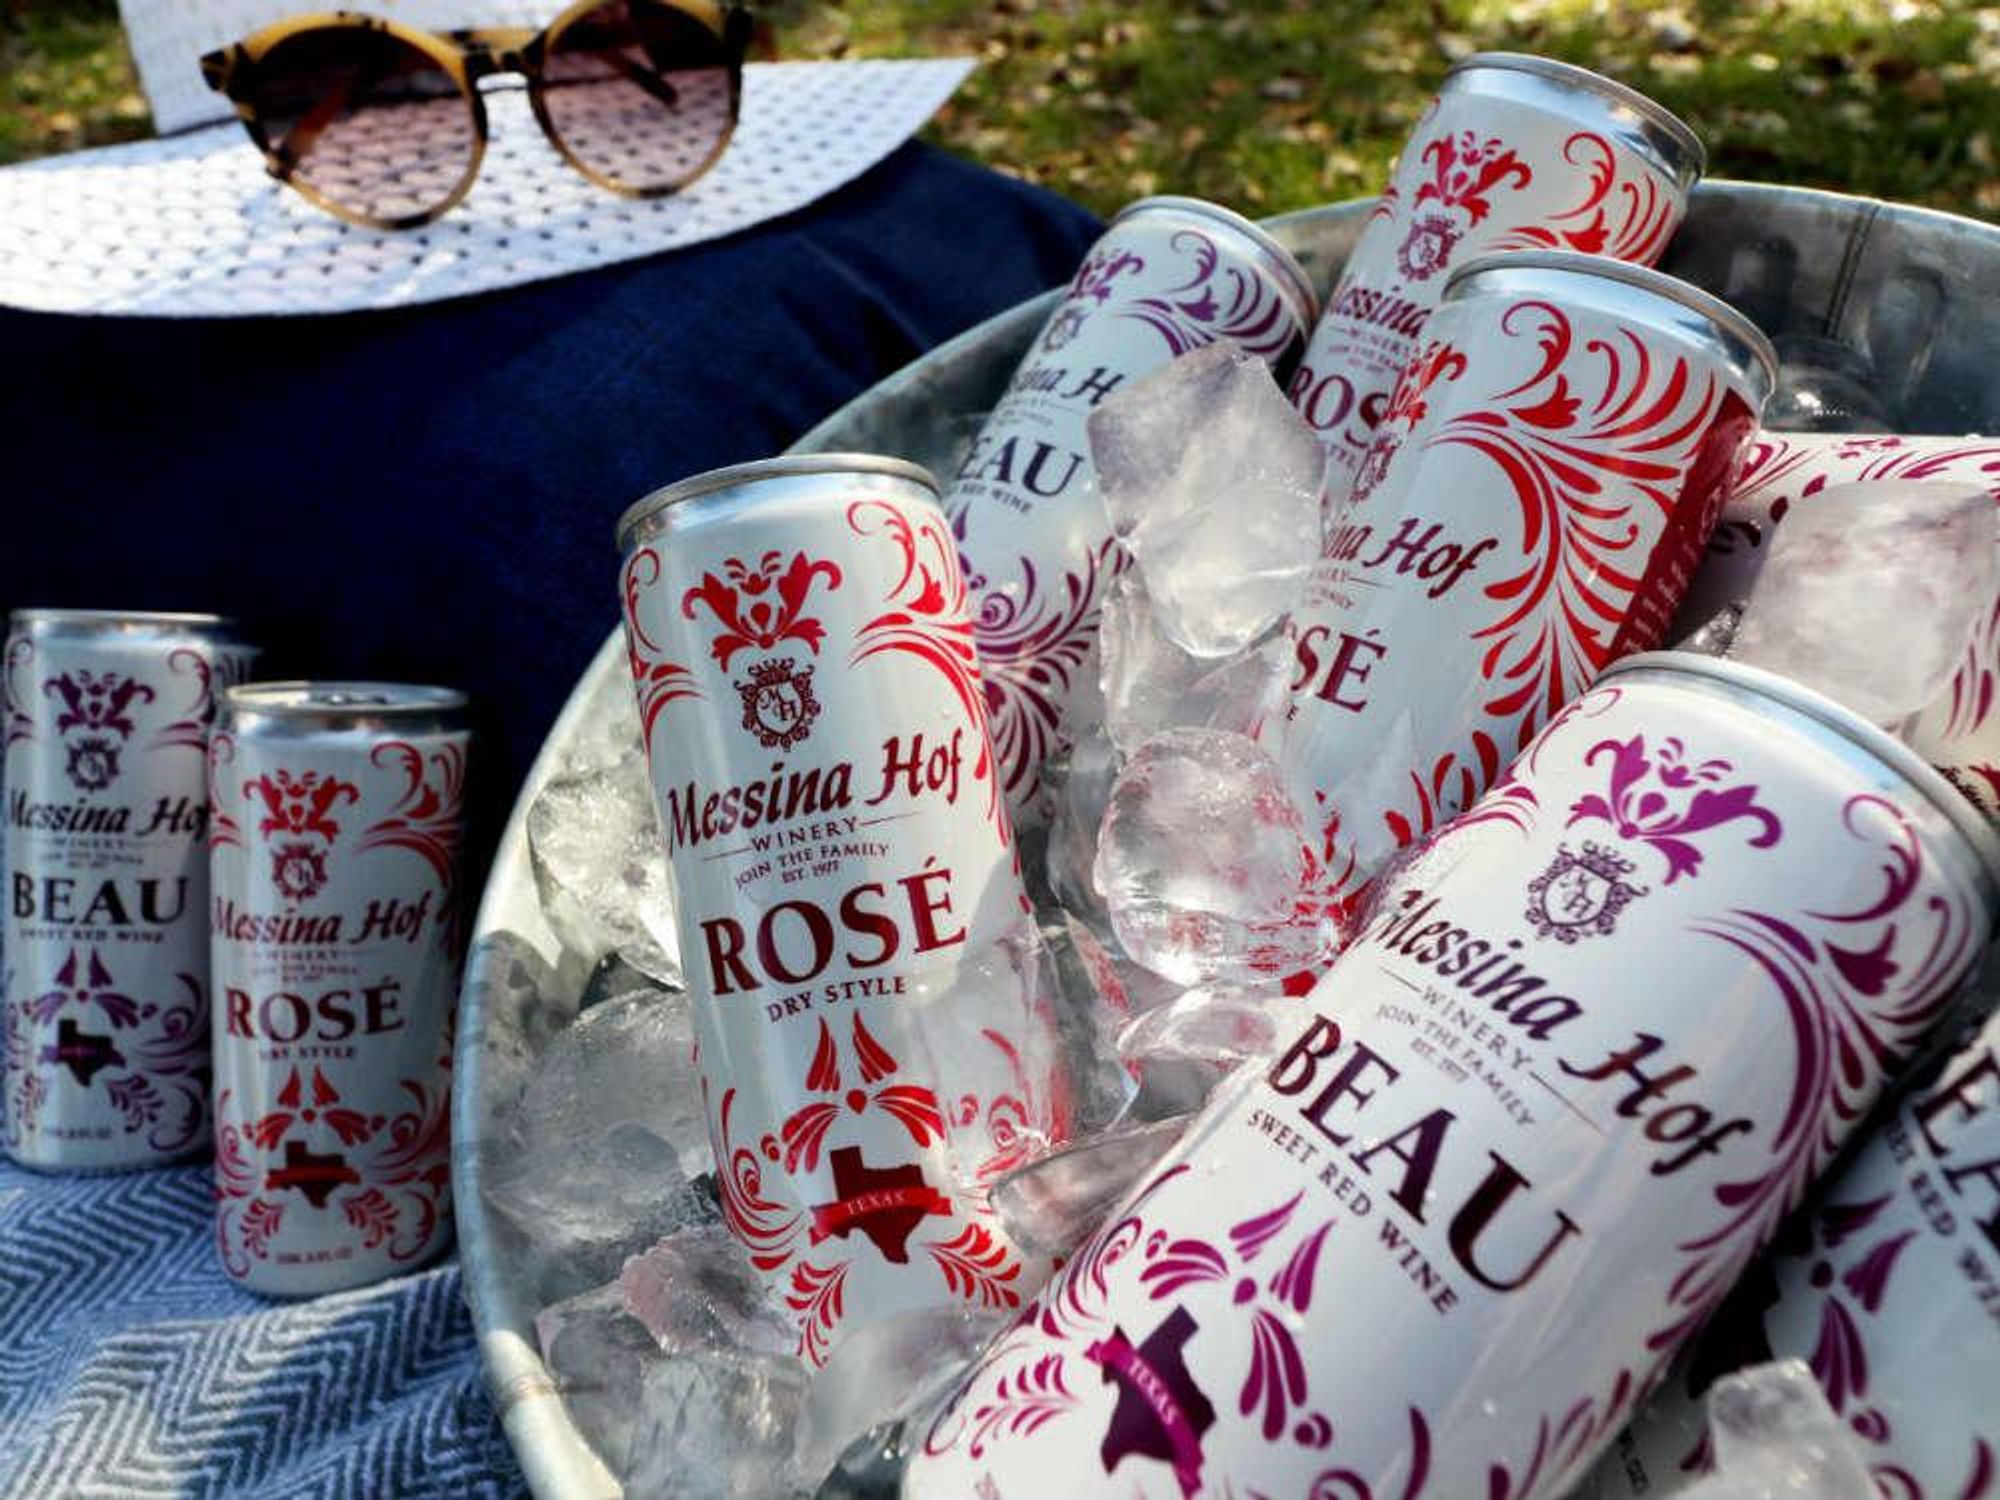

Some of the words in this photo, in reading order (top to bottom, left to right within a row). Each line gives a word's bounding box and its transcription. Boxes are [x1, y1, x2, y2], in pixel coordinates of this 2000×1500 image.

[1361, 518, 1499, 598] Hof
[1287, 621, 1388, 713] SÉ
[9, 788, 130, 833] Messina
[667, 762, 853, 850] Messina
[864, 726, 963, 806] Hof
[735, 862, 772, 890] JOIN
[778, 848, 813, 868] THE
[820, 842, 889, 859] FAMILY
[752, 816, 858, 852] WINERY
[13, 871, 191, 925] BEAU
[212, 897, 342, 945] Messina
[347, 889, 433, 945] Hof
[700, 856, 966, 996] ROSÉ
[225, 976, 405, 1043] ROSÉ
[769, 992, 814, 1023] DRY
[826, 976, 906, 1003] STYLE
[1376, 890, 1584, 1041] Messina
[1557, 1032, 1755, 1176] Hof
[1424, 985, 1533, 1069] WINERY
[1377, 1004, 1420, 1026] JOIN
[1424, 1021, 1460, 1050] THE
[1462, 1049, 1536, 1125] FAMILY
[1269, 1014, 1582, 1293] BEAU
[848, 1189, 907, 1215] TEXAS
[1247, 1108, 1320, 1164] SWEET
[1318, 1162, 1372, 1217] RED
[1379, 1219, 1460, 1315] WINE
[1128, 1359, 1181, 1427] TEXAS
